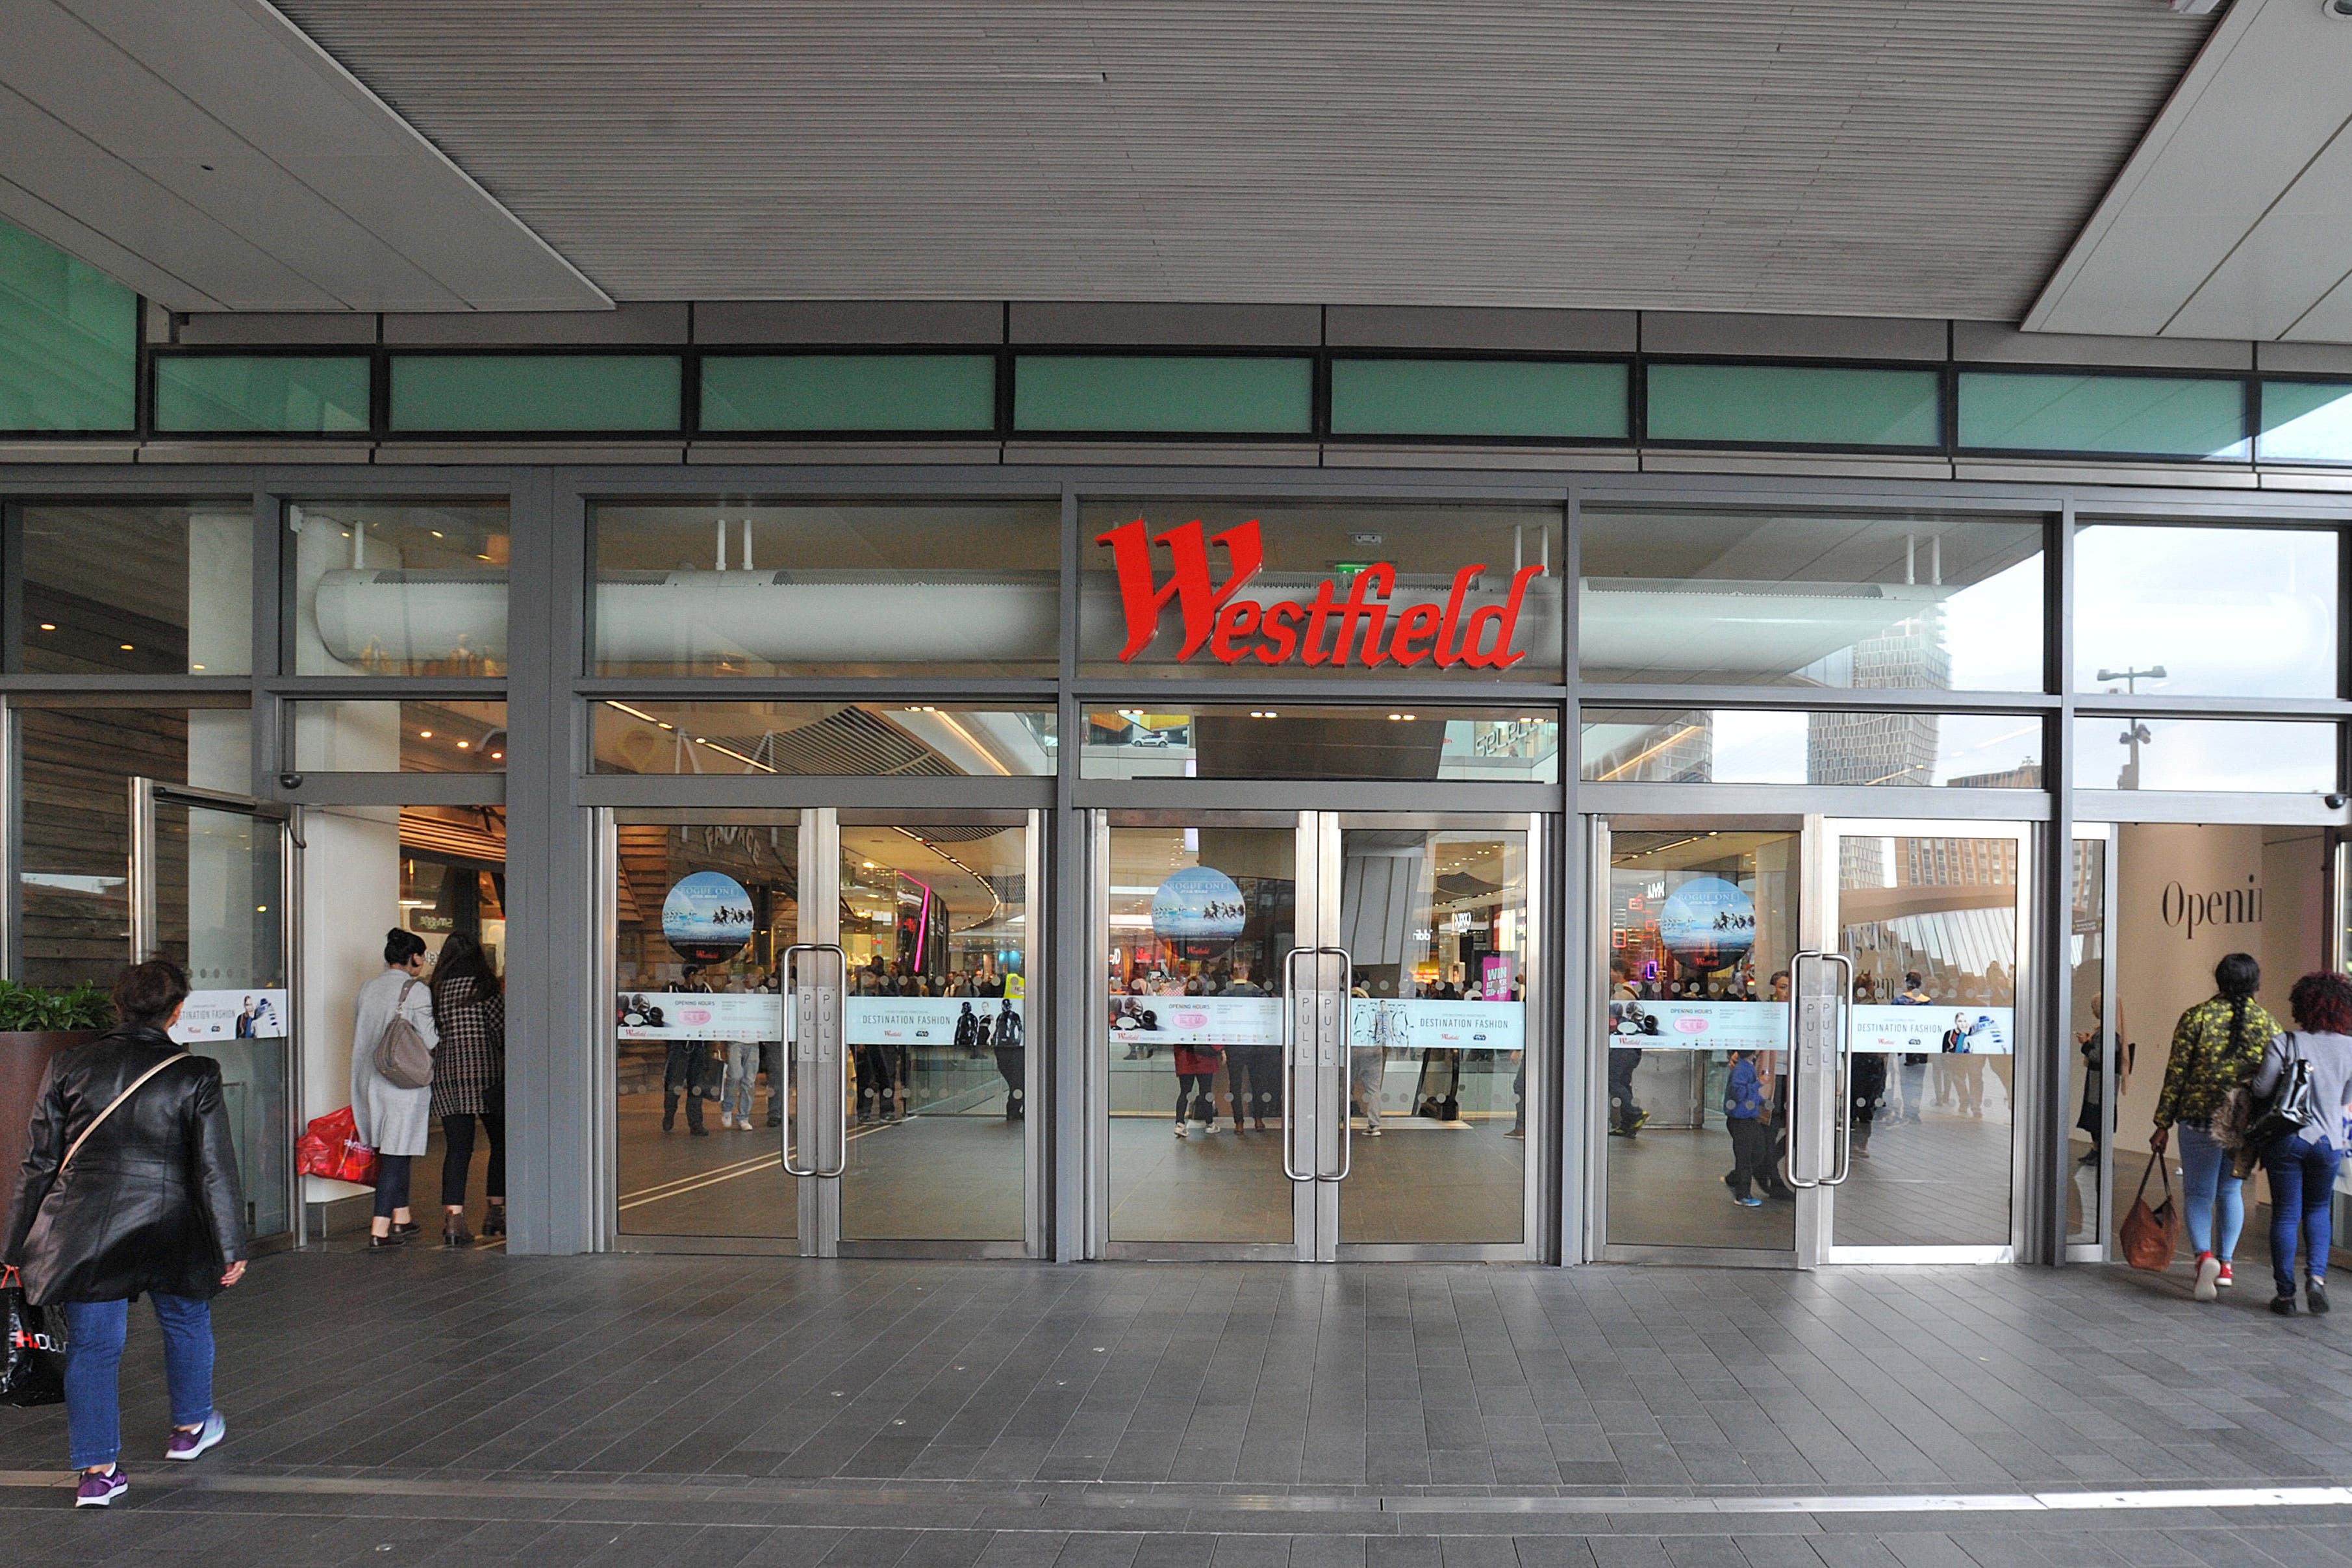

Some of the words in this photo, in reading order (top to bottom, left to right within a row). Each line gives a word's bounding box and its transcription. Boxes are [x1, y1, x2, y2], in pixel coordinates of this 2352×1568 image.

[1095, 518, 1545, 670] Westfield
[1487, 967, 1508, 981] WIN
[863, 1015, 914, 1024] DESTINATION
[917, 1015, 950, 1024] FASHION
[1420, 1018, 1472, 1028] DESTINATION
[1475, 1019, 1508, 1028] FASHION
[1857, 1023, 1907, 1032] DESTINATION
[1910, 1024, 1942, 1033] FASHION
